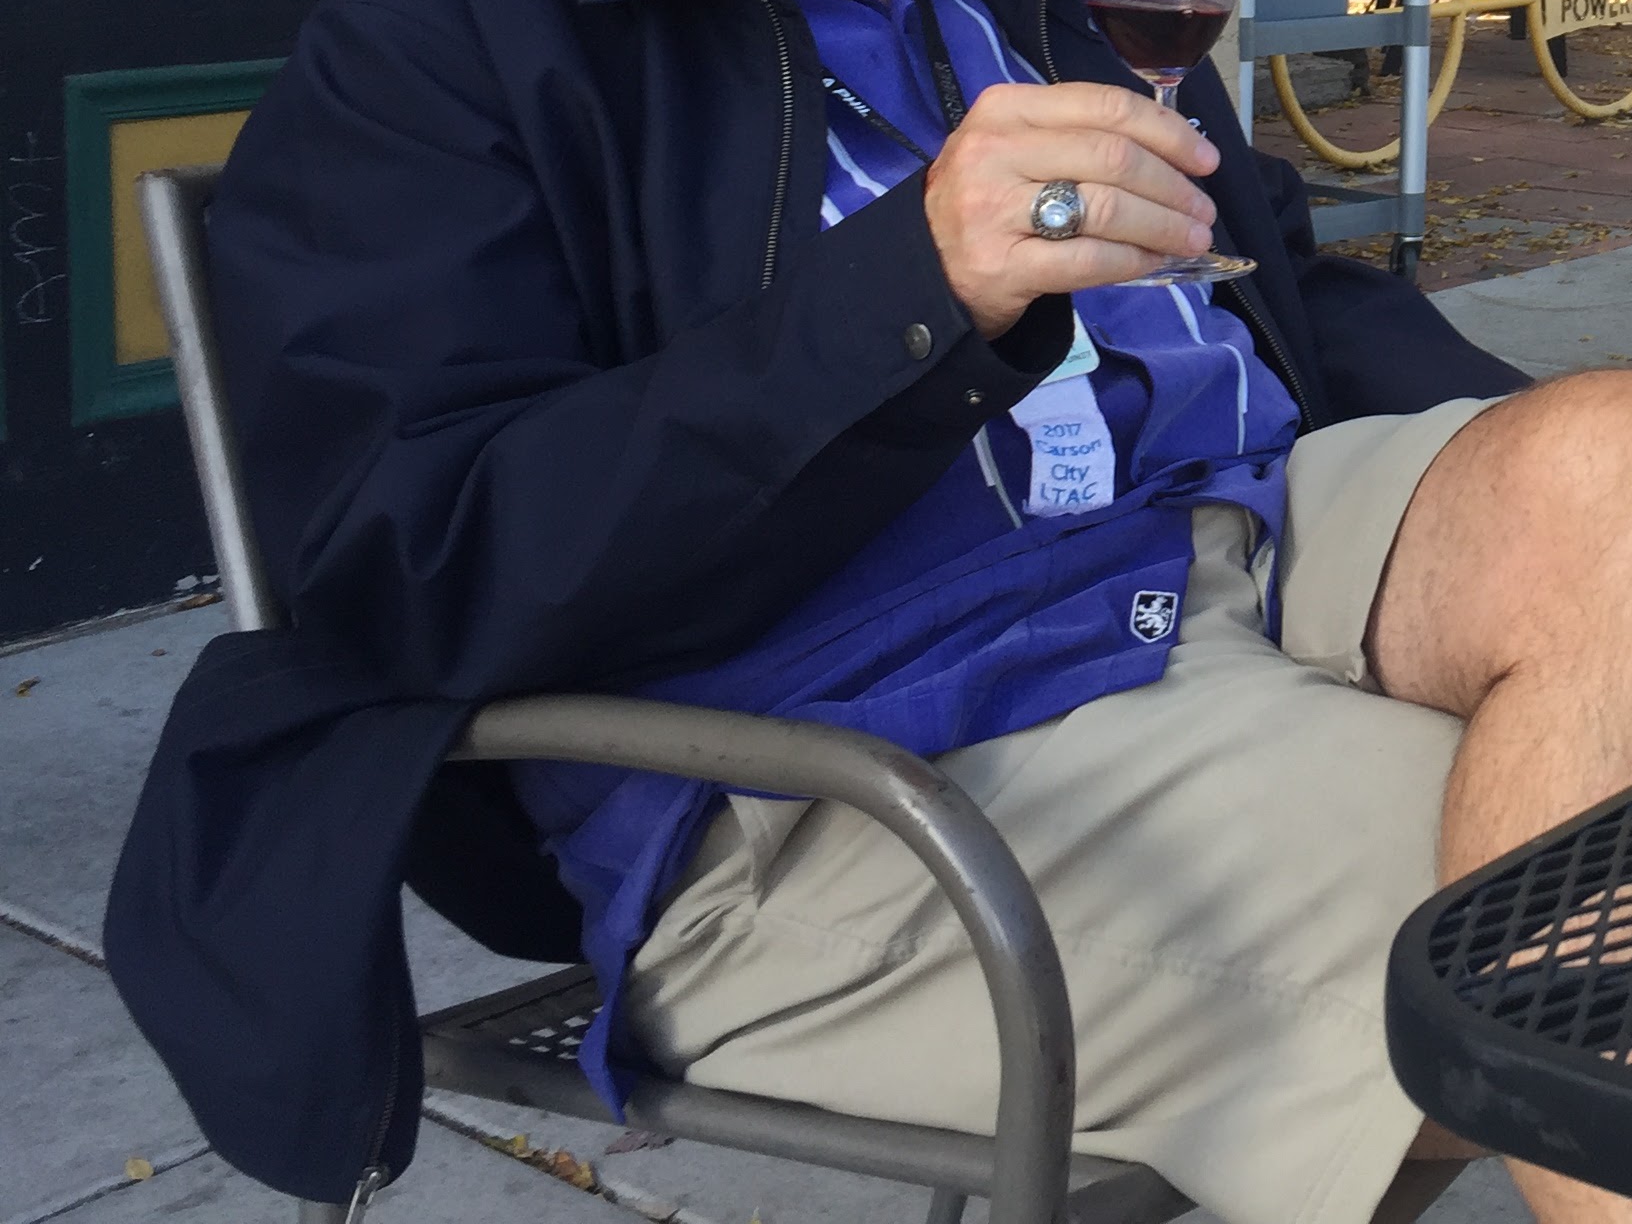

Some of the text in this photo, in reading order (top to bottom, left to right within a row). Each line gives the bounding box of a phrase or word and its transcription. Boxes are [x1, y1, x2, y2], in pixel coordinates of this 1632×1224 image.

[1042, 422, 1082, 437] 2017
[1034, 439, 1101, 457] Carson
[1050, 463, 1090, 483] City
[1040, 481, 1098, 506] LTAC
